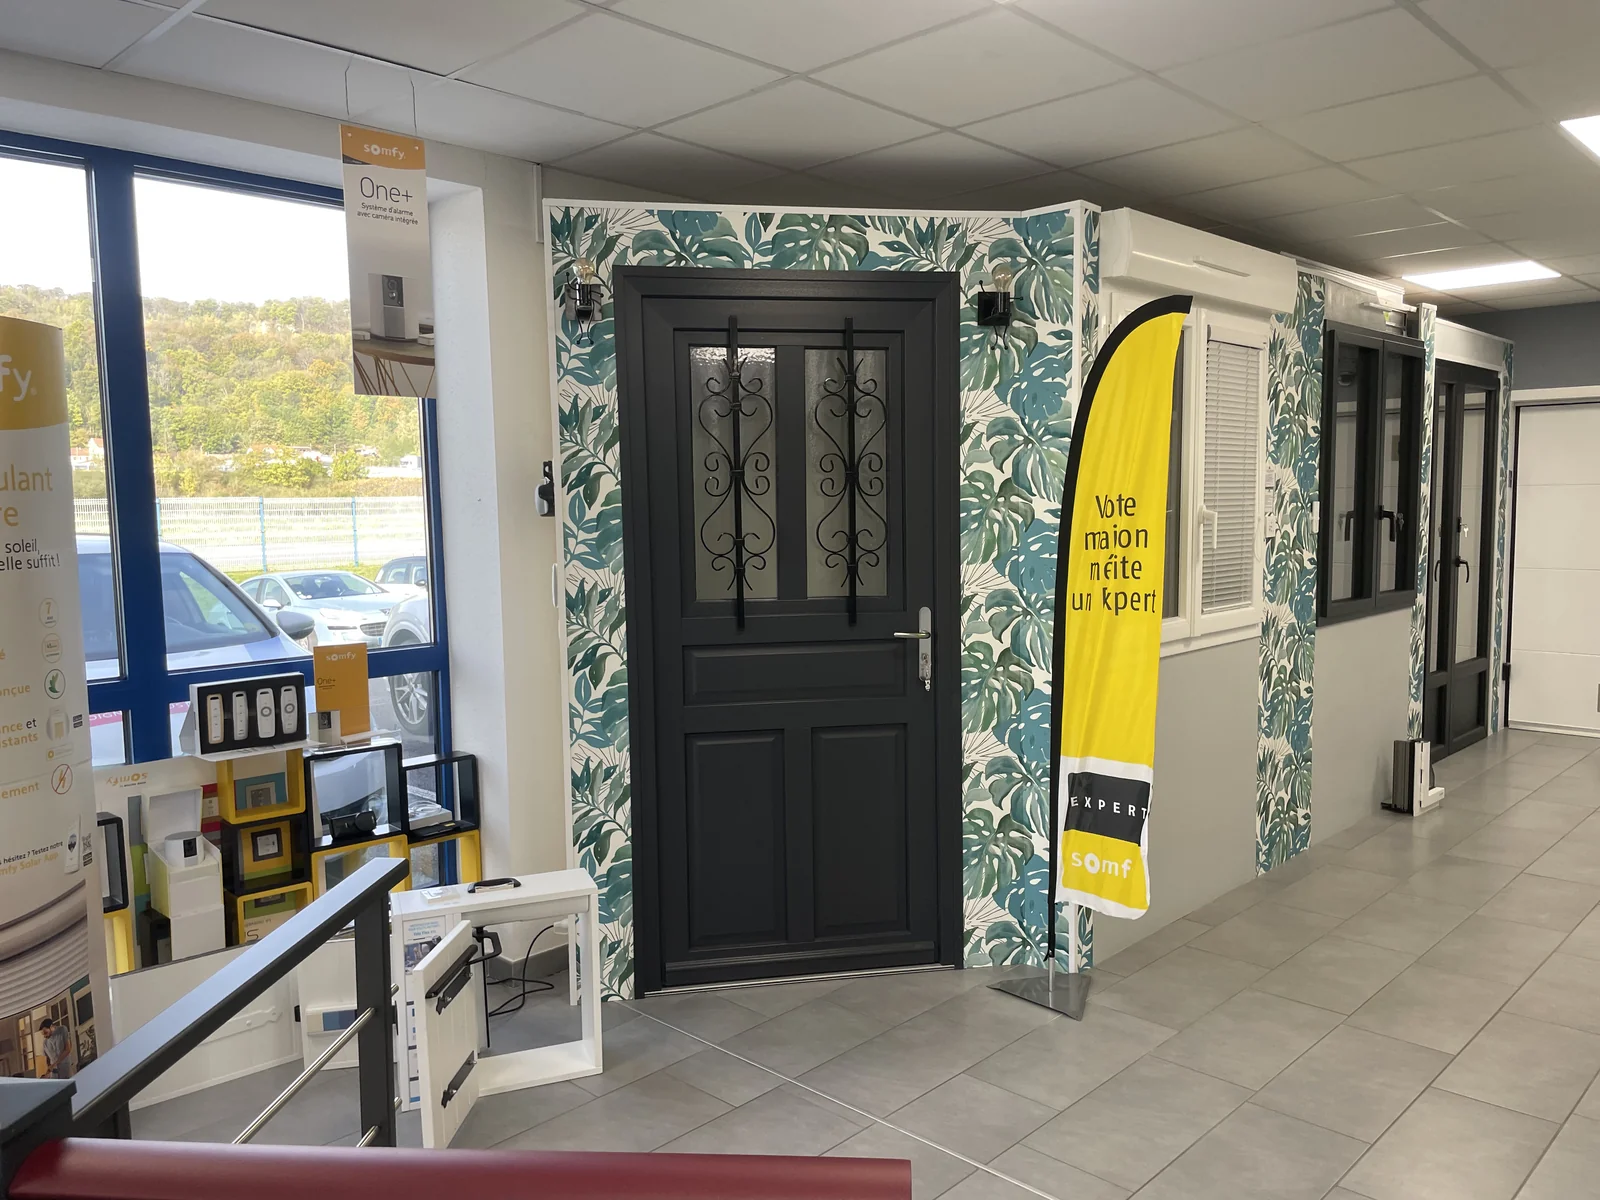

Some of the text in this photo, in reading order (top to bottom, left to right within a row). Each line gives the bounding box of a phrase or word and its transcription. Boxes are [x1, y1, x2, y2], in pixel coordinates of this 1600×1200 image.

[363, 144, 405, 160] somfy
[360, 176, 413, 203] One+
[361, 202, 413, 216] Système d'alarme
[372, 213, 394, 221] caméra
[395, 216, 419, 225] intégrée
[5, 538, 40, 555] soleil,
[326, 652, 356, 661] somfy
[0, 718, 37, 735] nce et
[1070, 796, 1148, 820] EXPERT
[1071, 852, 1132, 879] somf
